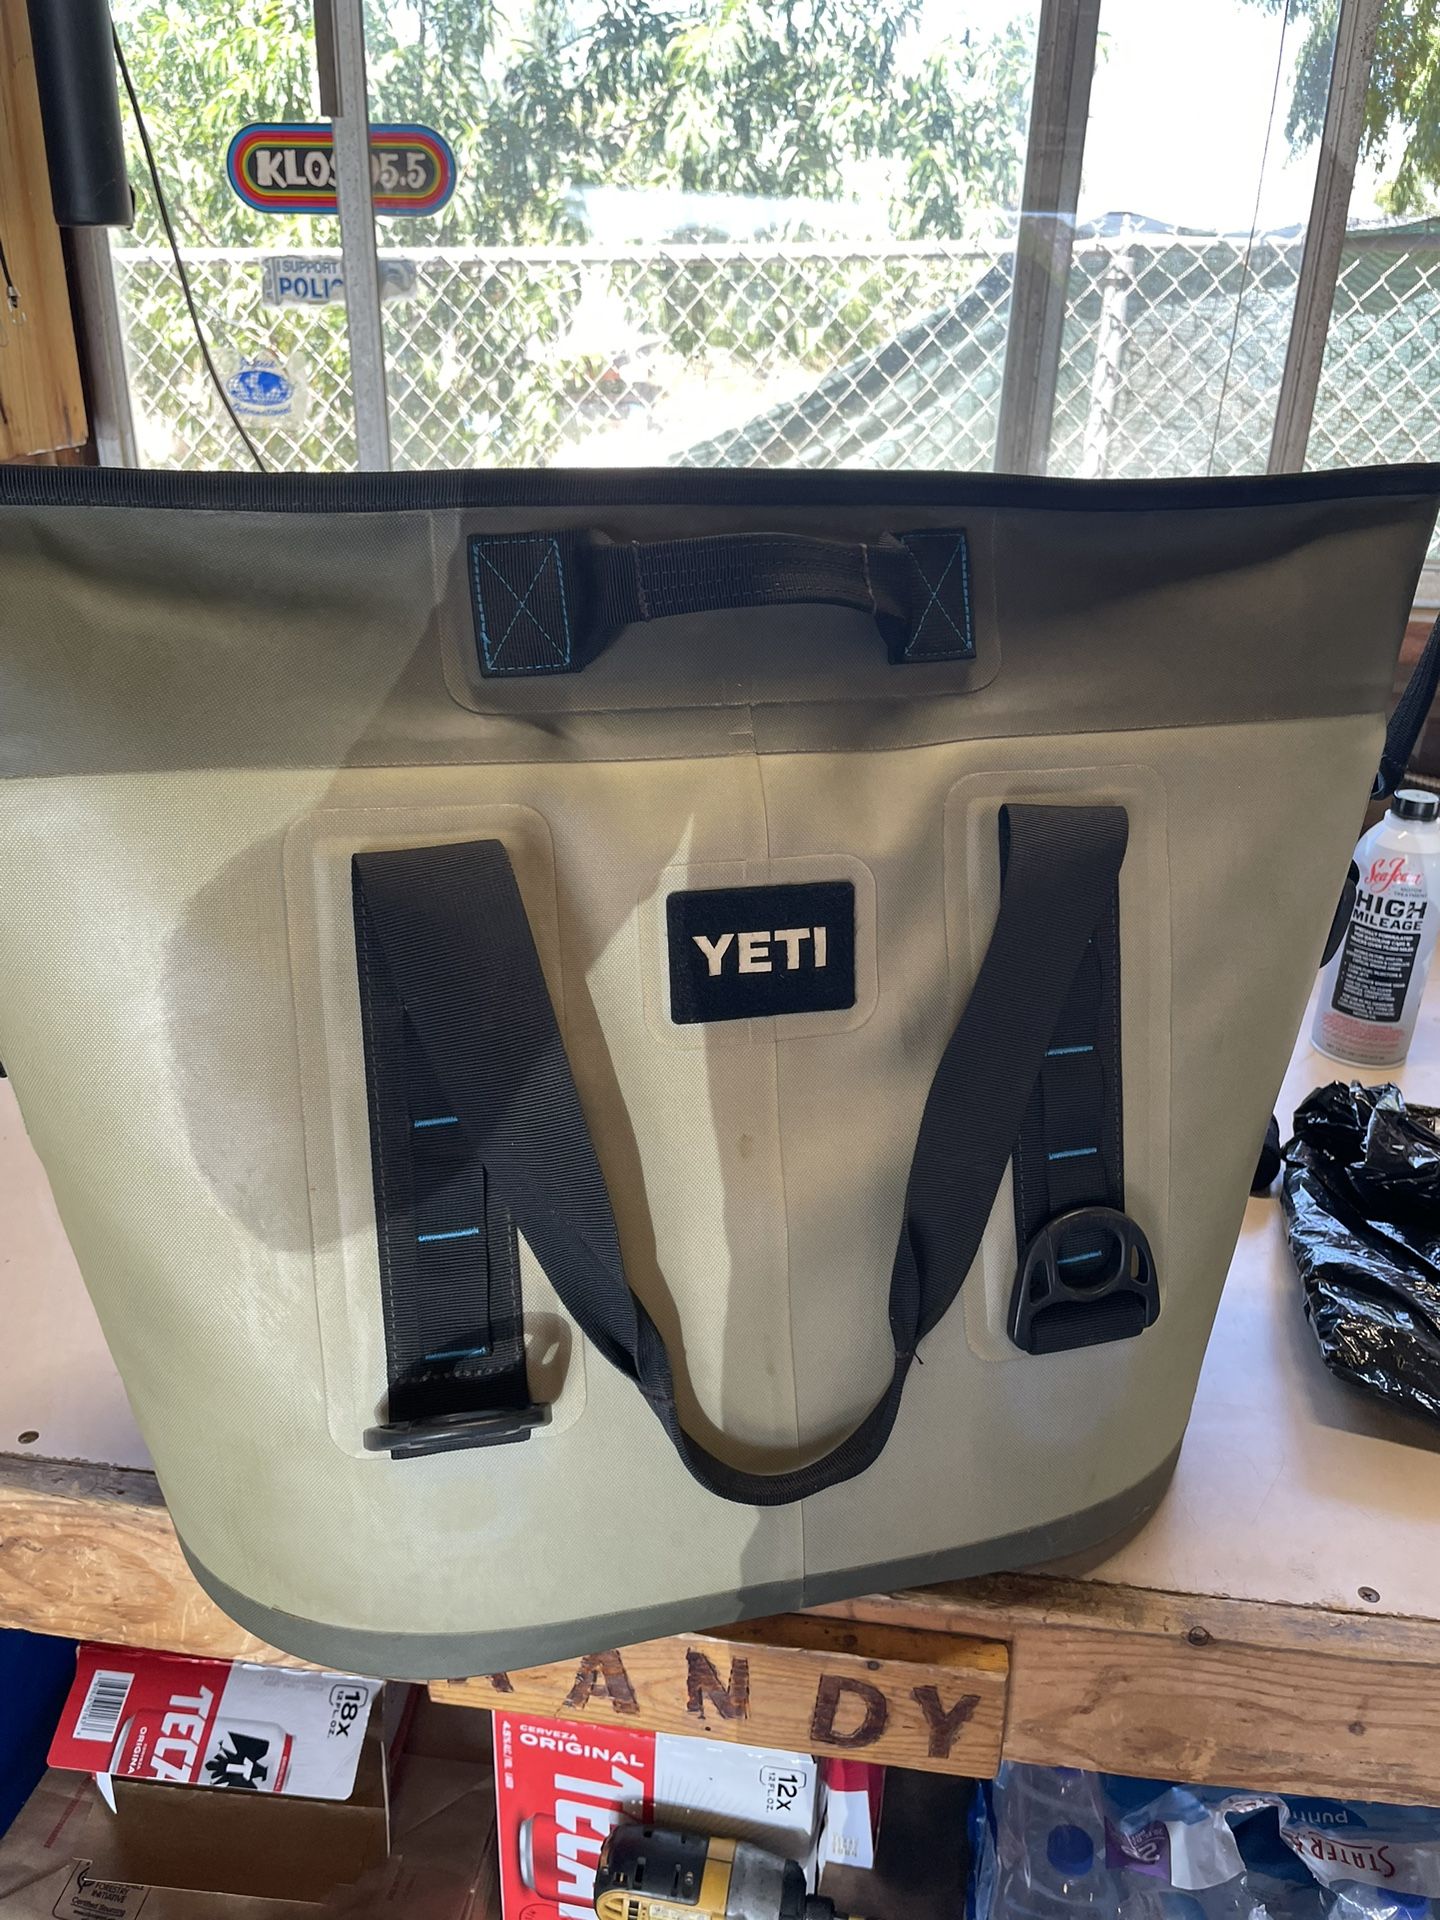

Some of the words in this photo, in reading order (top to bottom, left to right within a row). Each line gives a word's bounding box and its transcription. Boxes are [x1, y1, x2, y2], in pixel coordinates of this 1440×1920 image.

[283, 260, 337, 274] SUPPORT
[1356, 889, 1428, 919] HIGH
[1353, 908, 1424, 931] MILEAGE
[692, 926, 827, 977] YETI
[519, 1724, 578, 1741] CERVEZA
[520, 1733, 645, 1768] ORIGINAL
